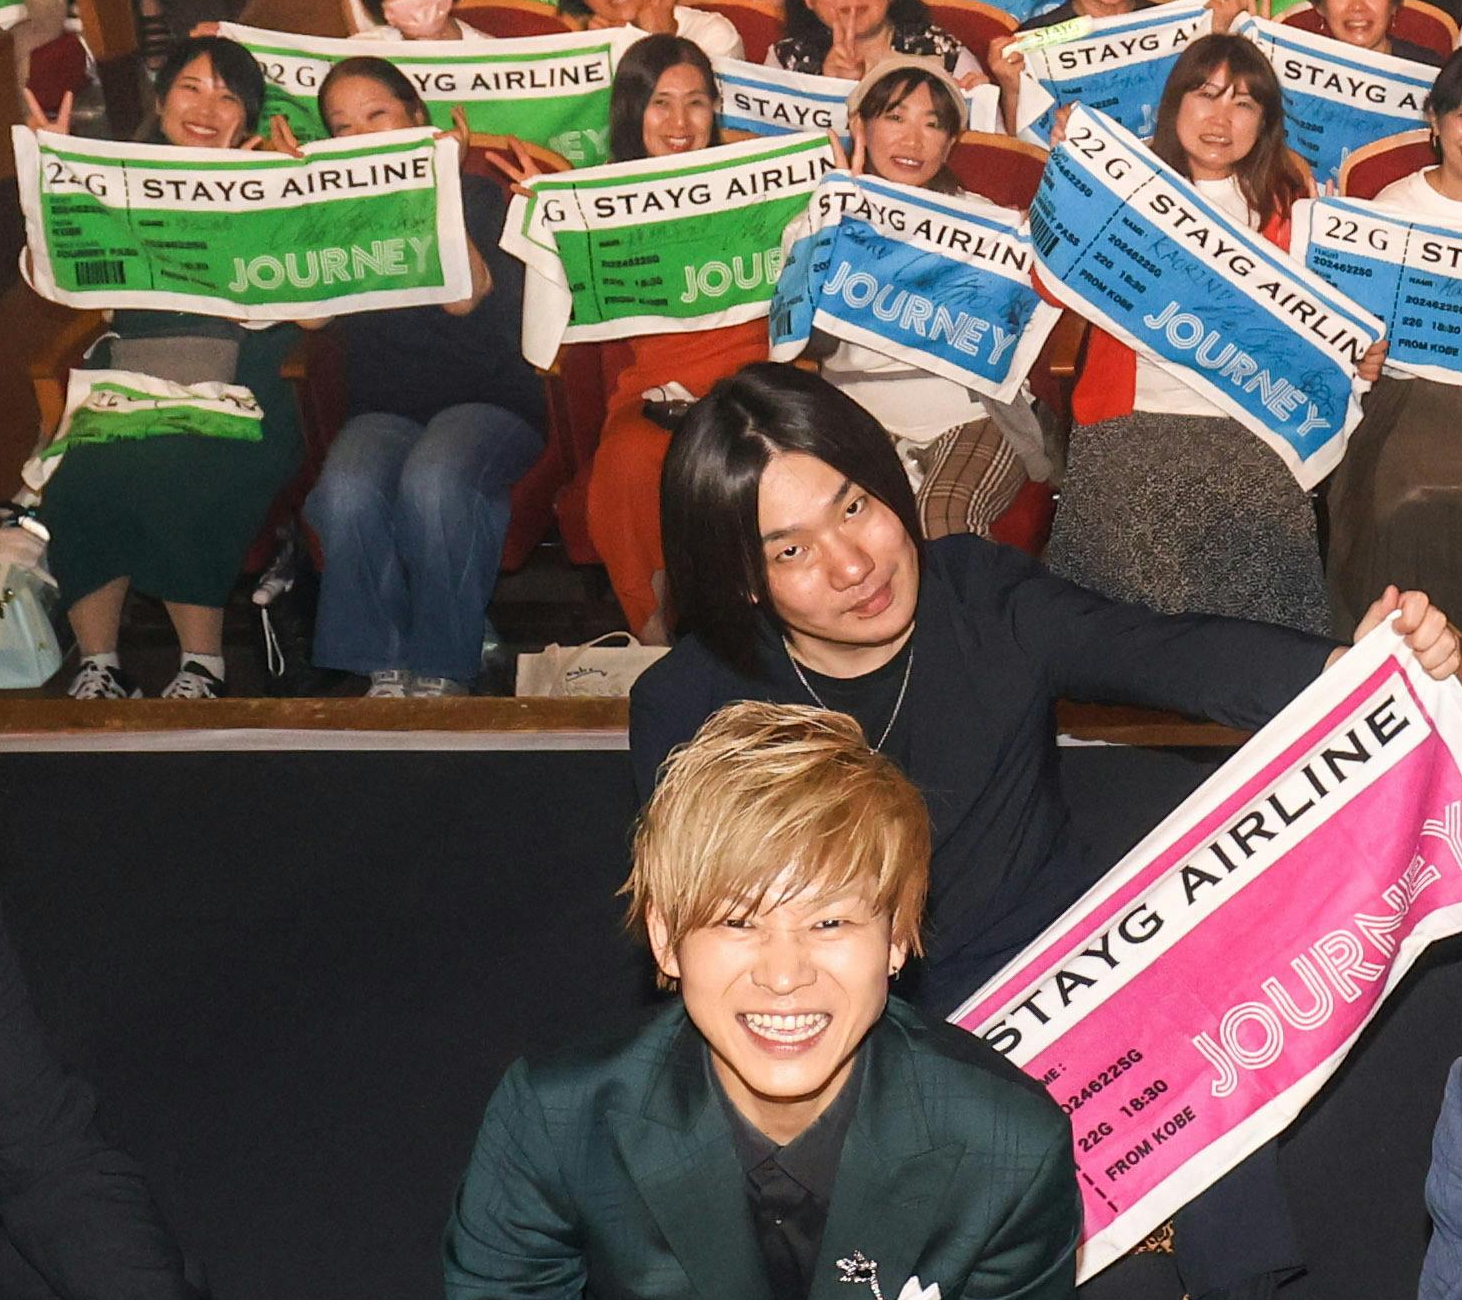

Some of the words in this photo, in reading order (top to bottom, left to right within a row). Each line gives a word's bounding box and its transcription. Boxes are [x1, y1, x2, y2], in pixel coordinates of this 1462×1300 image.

[142, 174, 265, 204] STAYG
[278, 156, 431, 199] AIRLINE
[1069, 127, 1107, 159] 22
[1105, 157, 1132, 180] G
[1148, 193, 1257, 278] STAYG
[228, 237, 436, 295] JOURNEY
[1325, 216, 1358, 243] 22
[1369, 229, 1388, 251] G
[1143, 301, 1331, 436] JOURNEY
[982, 903, 1164, 1057] STAYG
[1179, 694, 1411, 908] AIRLINE
[1060, 1049, 1143, 1116] 024622SG
[1078, 1122, 1113, 1153] 22G
[1120, 1079, 1168, 1118] 18:30
[1105, 1139, 1154, 1181] FROM
[1152, 1106, 1196, 1145] KOBE
